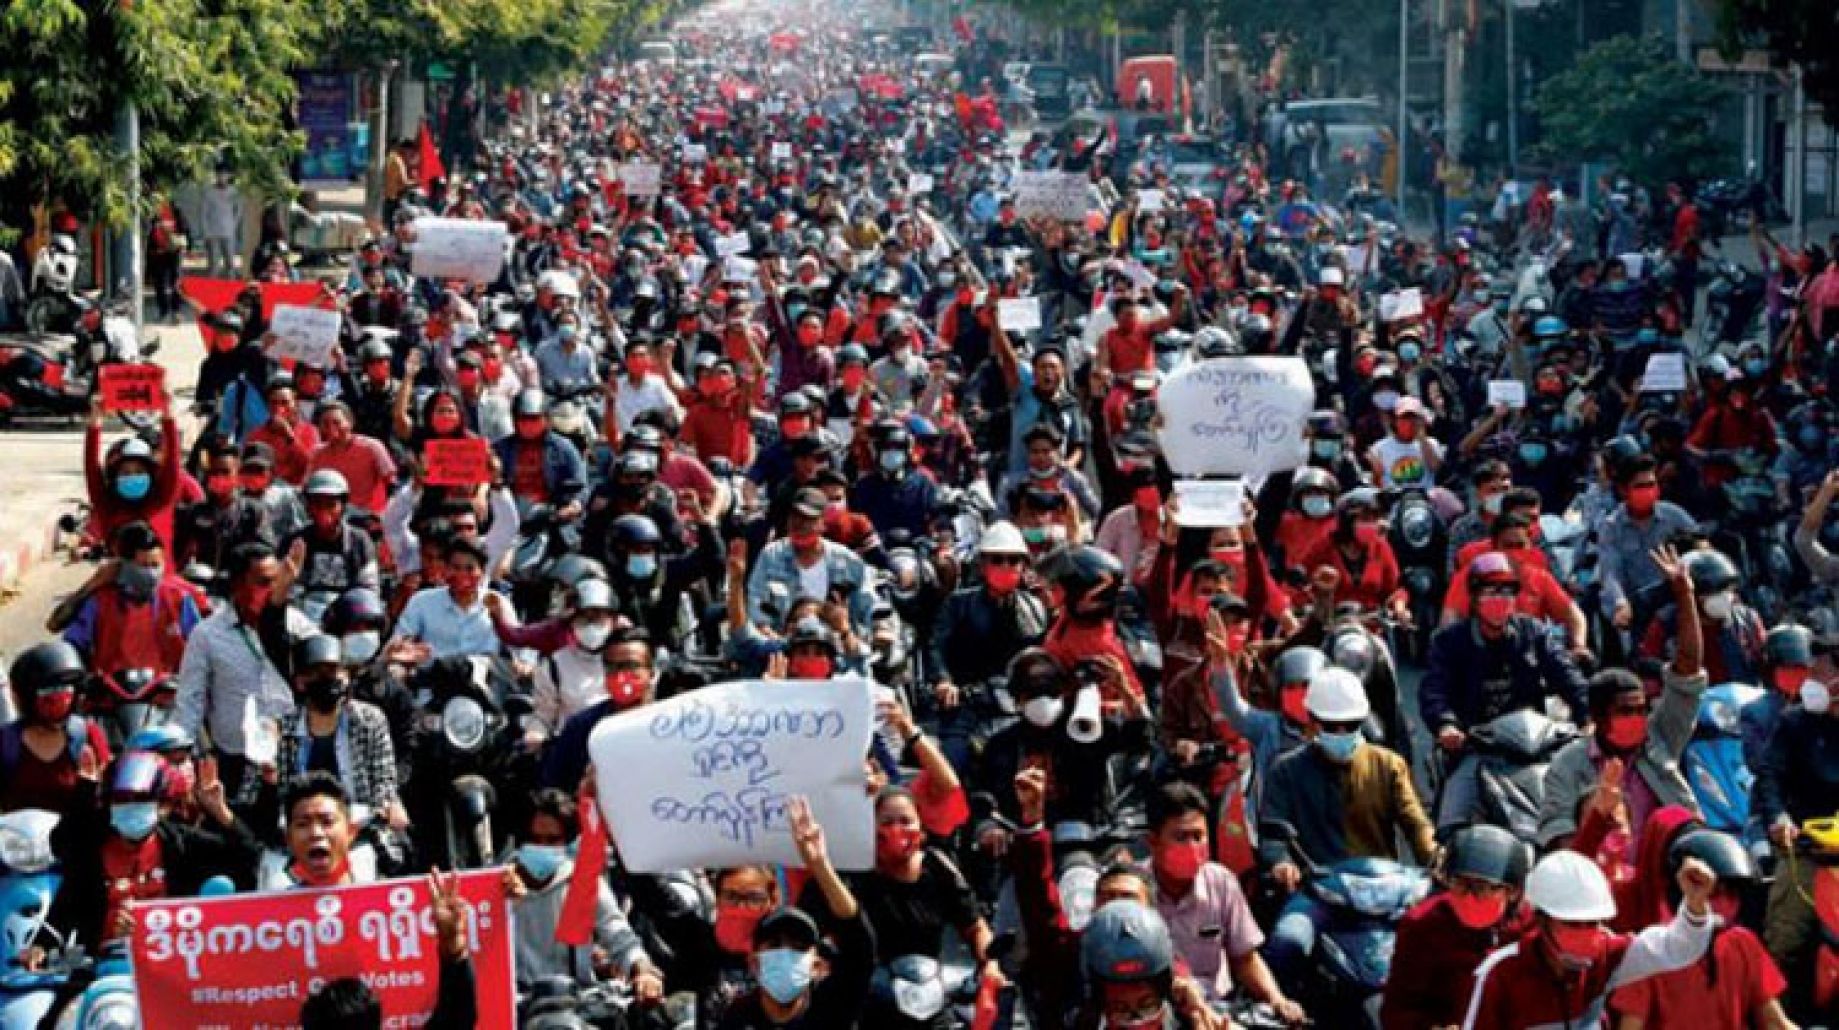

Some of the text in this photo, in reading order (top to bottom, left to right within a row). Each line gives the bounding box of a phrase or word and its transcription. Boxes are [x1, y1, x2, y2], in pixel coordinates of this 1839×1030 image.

[145, 895, 344, 979] ဒီမိုကရေစီ
[191, 981, 298, 1005] #Respect
